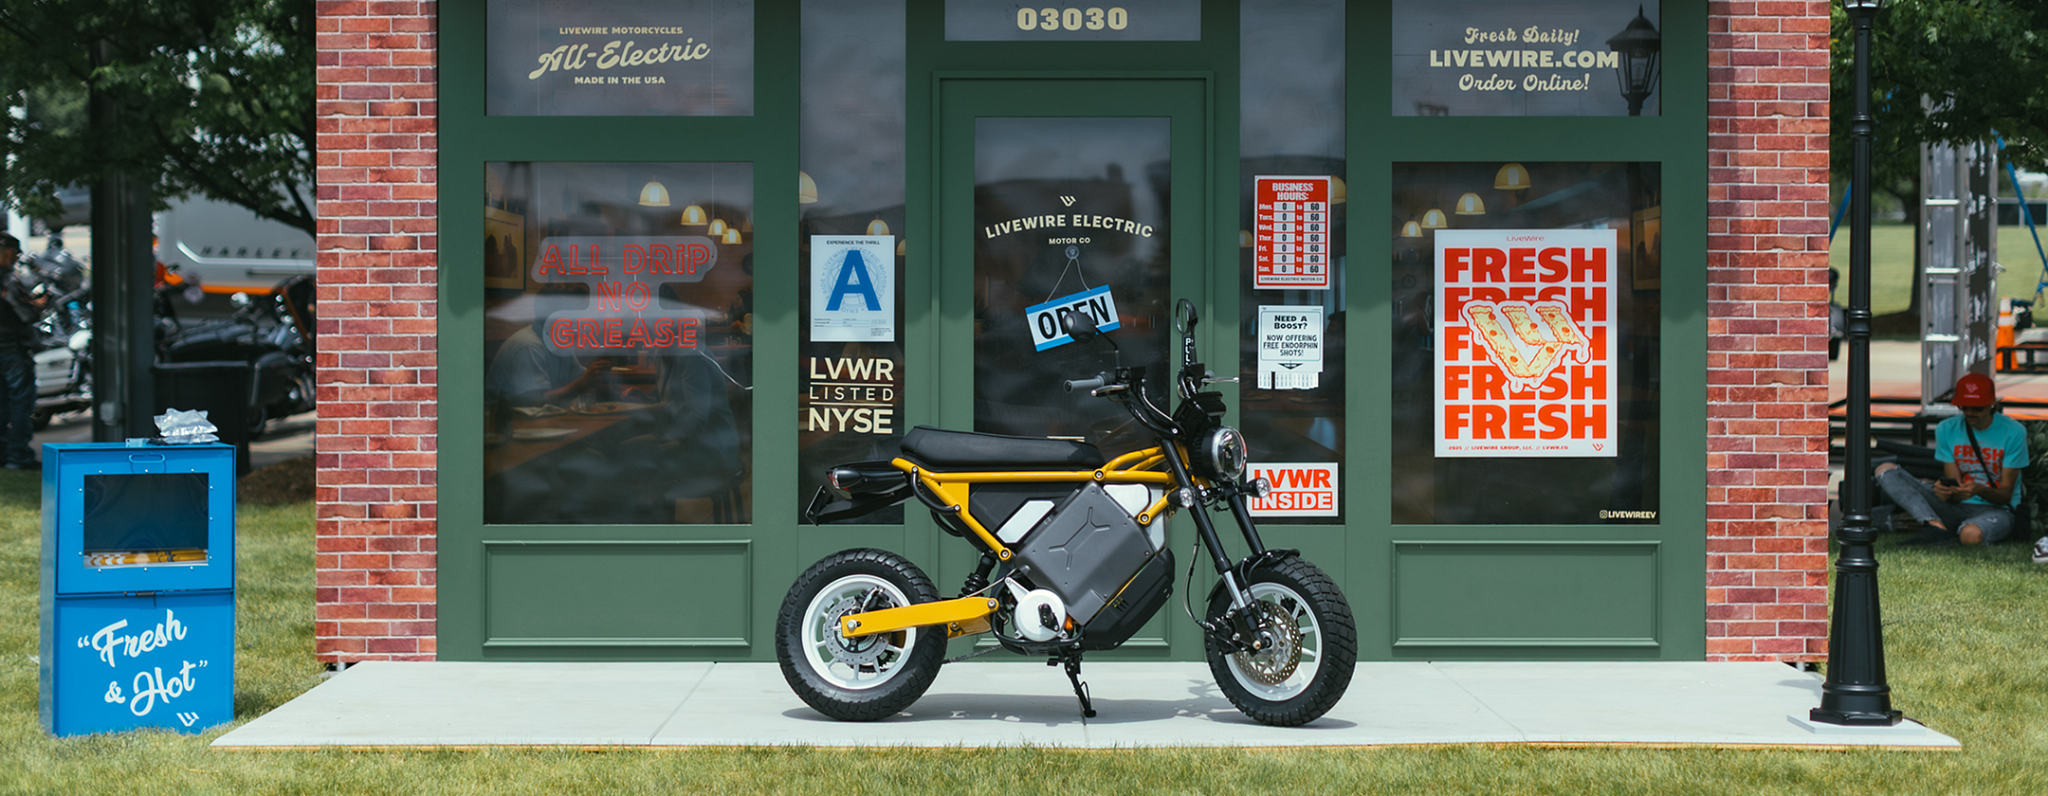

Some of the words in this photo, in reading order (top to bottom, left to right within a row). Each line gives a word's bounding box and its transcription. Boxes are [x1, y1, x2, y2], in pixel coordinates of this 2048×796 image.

[1017, 7, 1127, 30] 03030
[559, 27, 608, 35] LIVEWIRE
[612, 27, 683, 35] MOTORCYCLES
[1464, 26, 1517, 44] Fresh
[1522, 25, 1580, 46] Daily!
[528, 37, 711, 80] All-Electric
[1430, 49, 1619, 68] LIVEWIRE.COM
[574, 76, 605, 84] MADE
[607, 76, 619, 84] IN
[622, 76, 641, 84] THE
[644, 76, 666, 84] USA
[1458, 73, 1517, 91] Order
[1522, 73, 1590, 92] Online!
[1272, 183, 1314, 191] BUSINESS
[1277, 192, 1309, 200] HOURS:
[985, 214, 1066, 239] LIVEWIRE
[1072, 214, 1154, 238] ELECTRIC
[1049, 237, 1077, 245] MOTOR
[539, 244, 609, 275] ALL
[623, 243, 710, 275] DRIP
[1444, 247, 1607, 283] FRESH
[825, 250, 882, 311] A
[597, 281, 651, 311] NO
[550, 318, 698, 348] GREASE
[810, 357, 894, 381] LVWR
[809, 386, 894, 401] LISTED
[1444, 365, 1607, 400] FRSH
[808, 407, 894, 434] NYSE
[1444, 403, 1607, 440] FRESH
[1953, 444, 2004, 461] FRSH
[1254, 493, 1331, 509] INSIDE
[1608, 510, 1656, 519] LIVEWIREEV
[104, 680, 126, 704] &
